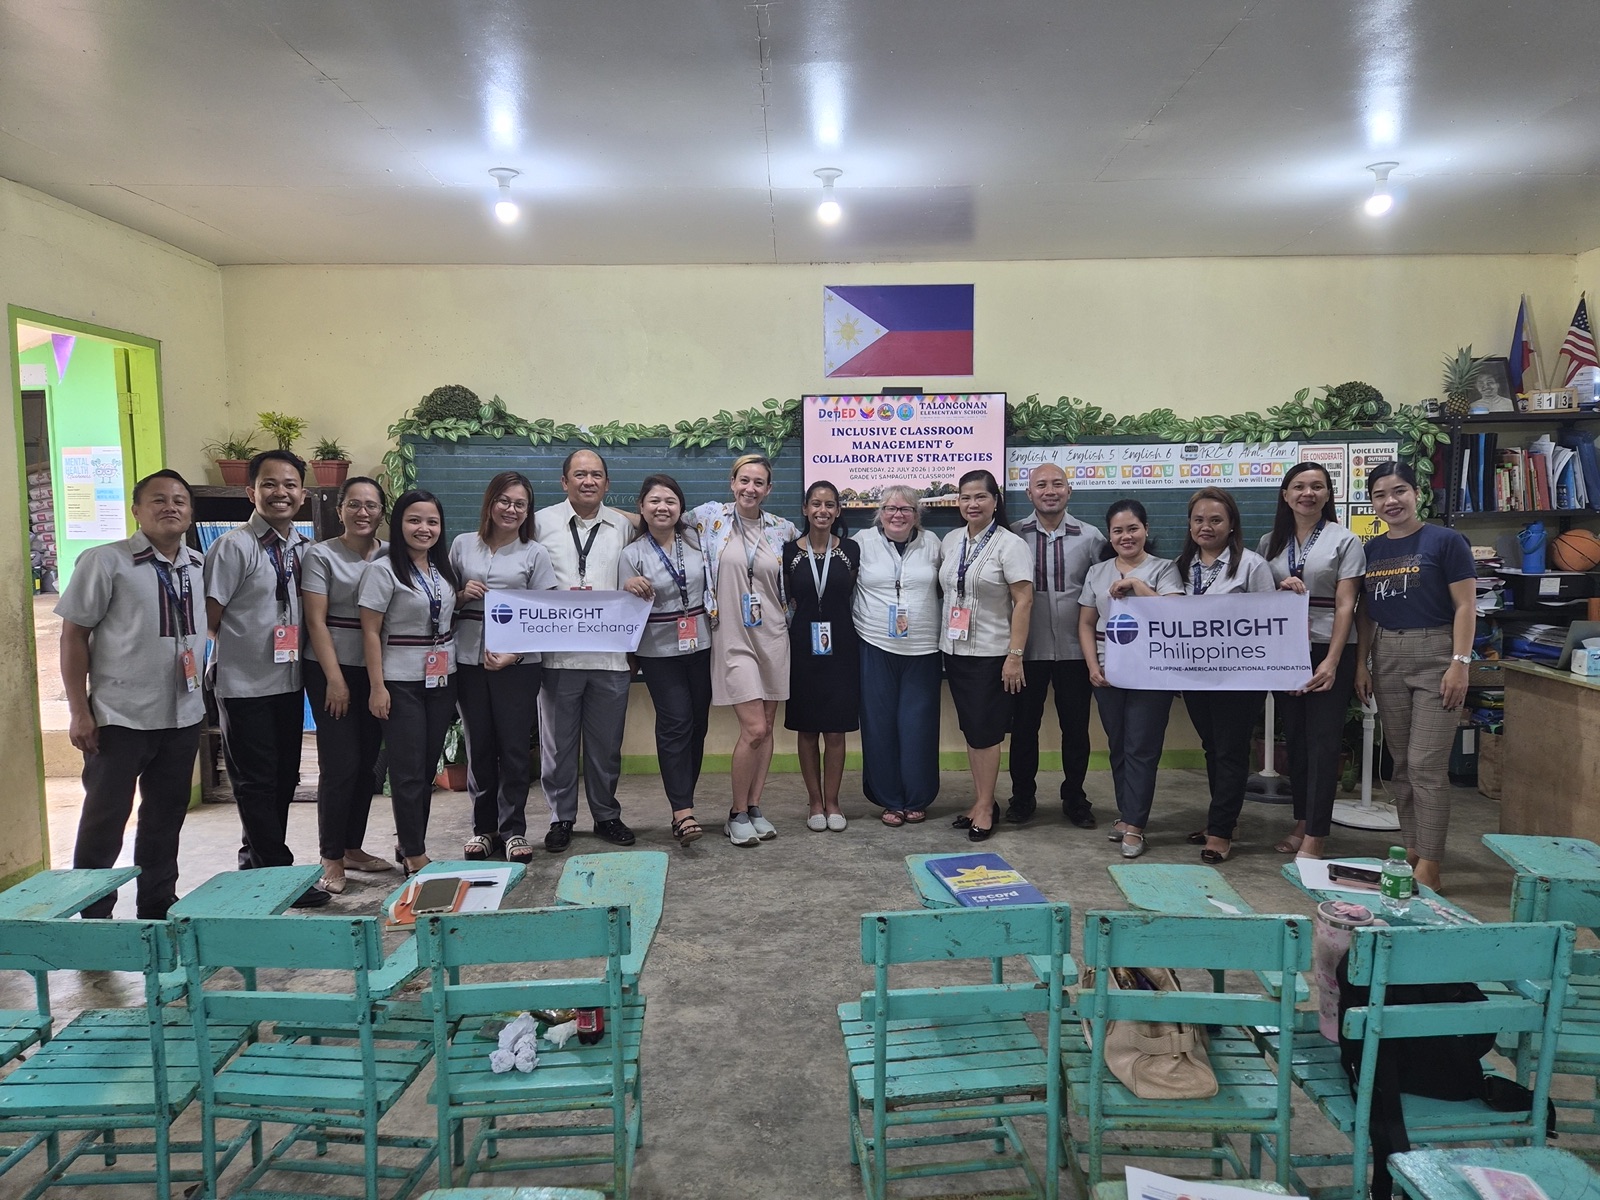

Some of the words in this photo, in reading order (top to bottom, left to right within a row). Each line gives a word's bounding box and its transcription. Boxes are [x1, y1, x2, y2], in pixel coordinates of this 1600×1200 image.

[919, 402, 988, 410] TALONGONAN
[1547, 396, 1552, 407] 1
[1562, 396, 1568, 406] 3
[819, 406, 856, 421] DepED
[831, 427, 897, 437] INCLUSIVE
[900, 426, 974, 436] CLASSROOM
[852, 440, 943, 450] MANAGEMENT
[945, 440, 954, 449] &
[1010, 450, 1047, 464] English
[1052, 450, 1058, 461] 4
[1066, 449, 1105, 463] English
[1109, 449, 1115, 460] 5
[1122, 448, 1162, 463] English
[1165, 448, 1172, 459] 6
[1227, 447, 1234, 458] 6
[1290, 447, 1296, 456] 6
[1310, 452, 1343, 460] CONSIDERATE
[65, 457, 89, 466] MENTAL
[812, 453, 913, 464] COLLABORATIVE
[917, 452, 993, 463] STRATEGIES
[1355, 456, 1360, 465] 3
[65, 466, 89, 474] HEALTH
[1066, 466, 1116, 478] TODAY
[1122, 465, 1174, 477] TODAY
[1180, 464, 1233, 477] TODAY
[1356, 480, 1360, 488] 1
[1355, 492, 1361, 500] 0
[519, 608, 604, 620] FULBRIGHT
[520, 622, 573, 633] Teacher
[1149, 617, 1288, 638] FULBRIGHT
[1149, 641, 1266, 663] Philippines
[972, 890, 1019, 901] record
